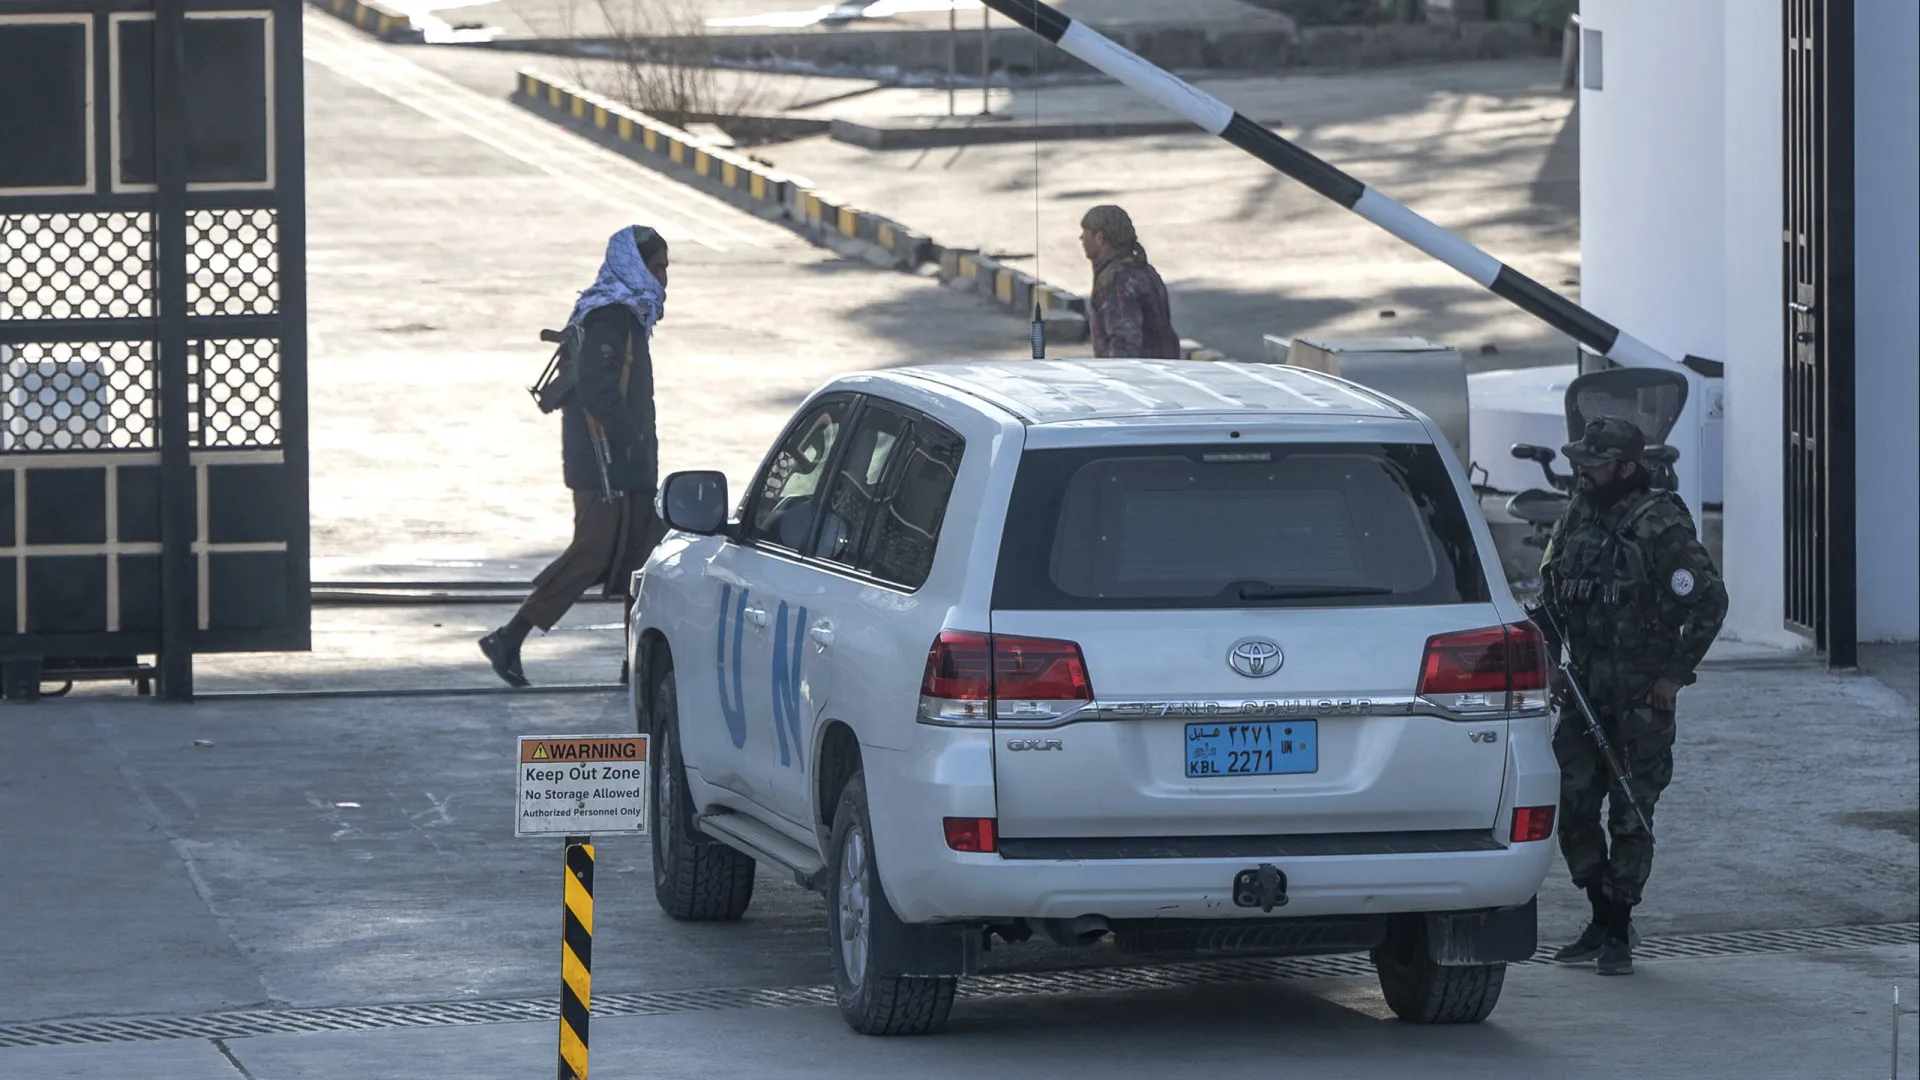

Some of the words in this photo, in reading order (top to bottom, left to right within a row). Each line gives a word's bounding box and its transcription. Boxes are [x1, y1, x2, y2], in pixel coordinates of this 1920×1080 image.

[717, 582, 808, 773] UN
[1141, 701, 1220, 716] LAND
[1240, 699, 1373, 715] CRUISER
[1467, 731, 1497, 743] V8
[549, 743, 636, 759] WARNING
[1006, 739, 1063, 751] GXR
[1281, 740, 1293, 754] UN
[1190, 760, 1219, 774] KBL
[1227, 750, 1273, 772] 2271
[526, 768, 564, 784] Keep
[569, 767, 597, 780] Out
[602, 767, 640, 780] Zone
[525, 790, 541, 800] No
[545, 789, 589, 801] Storage
[593, 788, 640, 799] Allowed
[523, 808, 571, 817] Authorized
[574, 808, 617, 816] Personnel
[620, 807, 641, 818] Only
